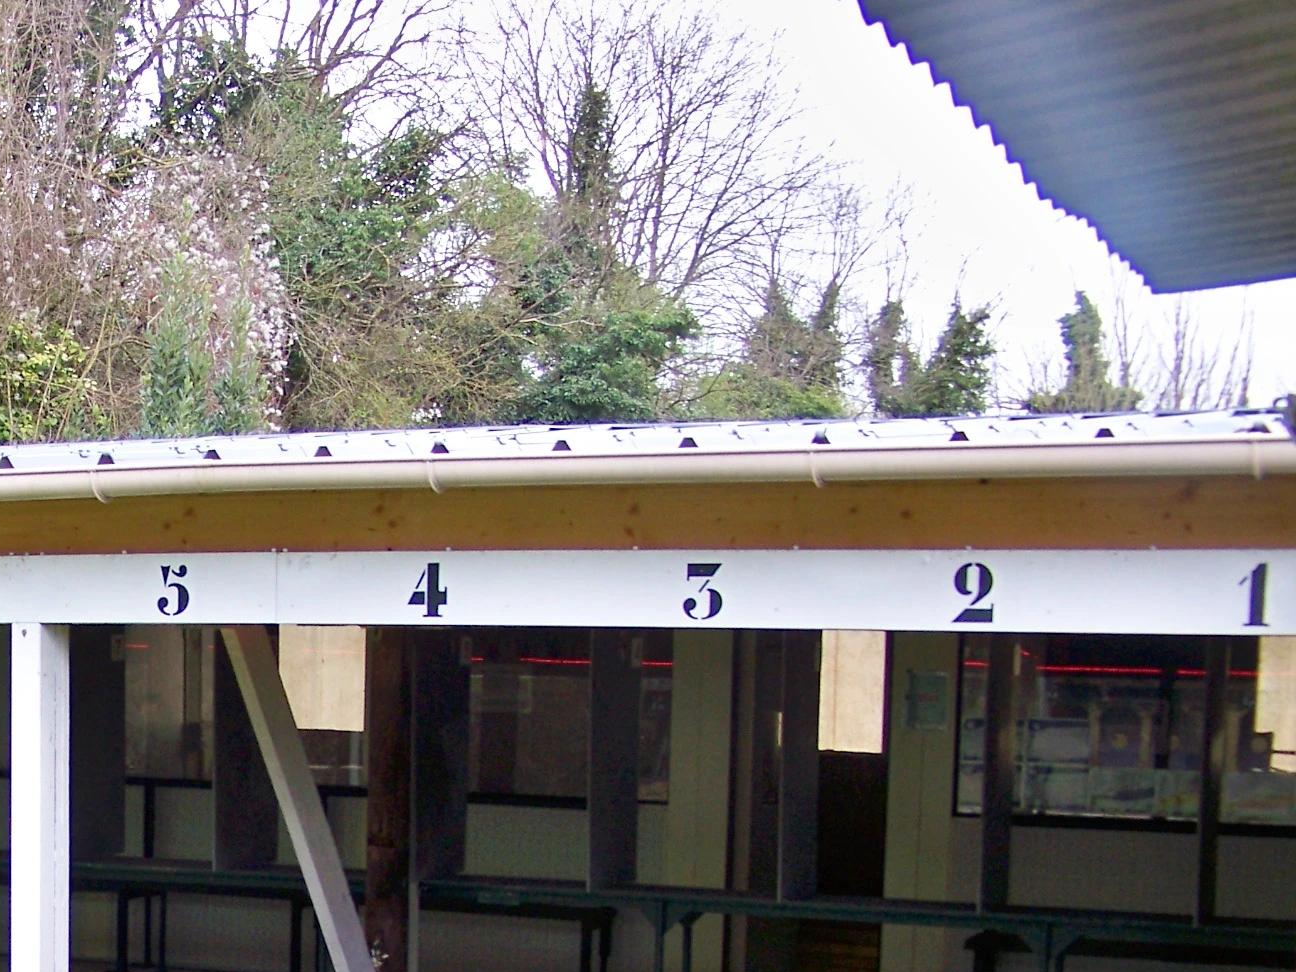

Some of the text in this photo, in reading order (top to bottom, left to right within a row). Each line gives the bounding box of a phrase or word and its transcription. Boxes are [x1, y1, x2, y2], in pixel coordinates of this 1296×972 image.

[157, 564, 190, 616] 5
[406, 562, 448, 618] 4
[682, 563, 723, 620] 3
[951, 562, 994, 623] 2
[1237, 563, 1268, 627] 1
